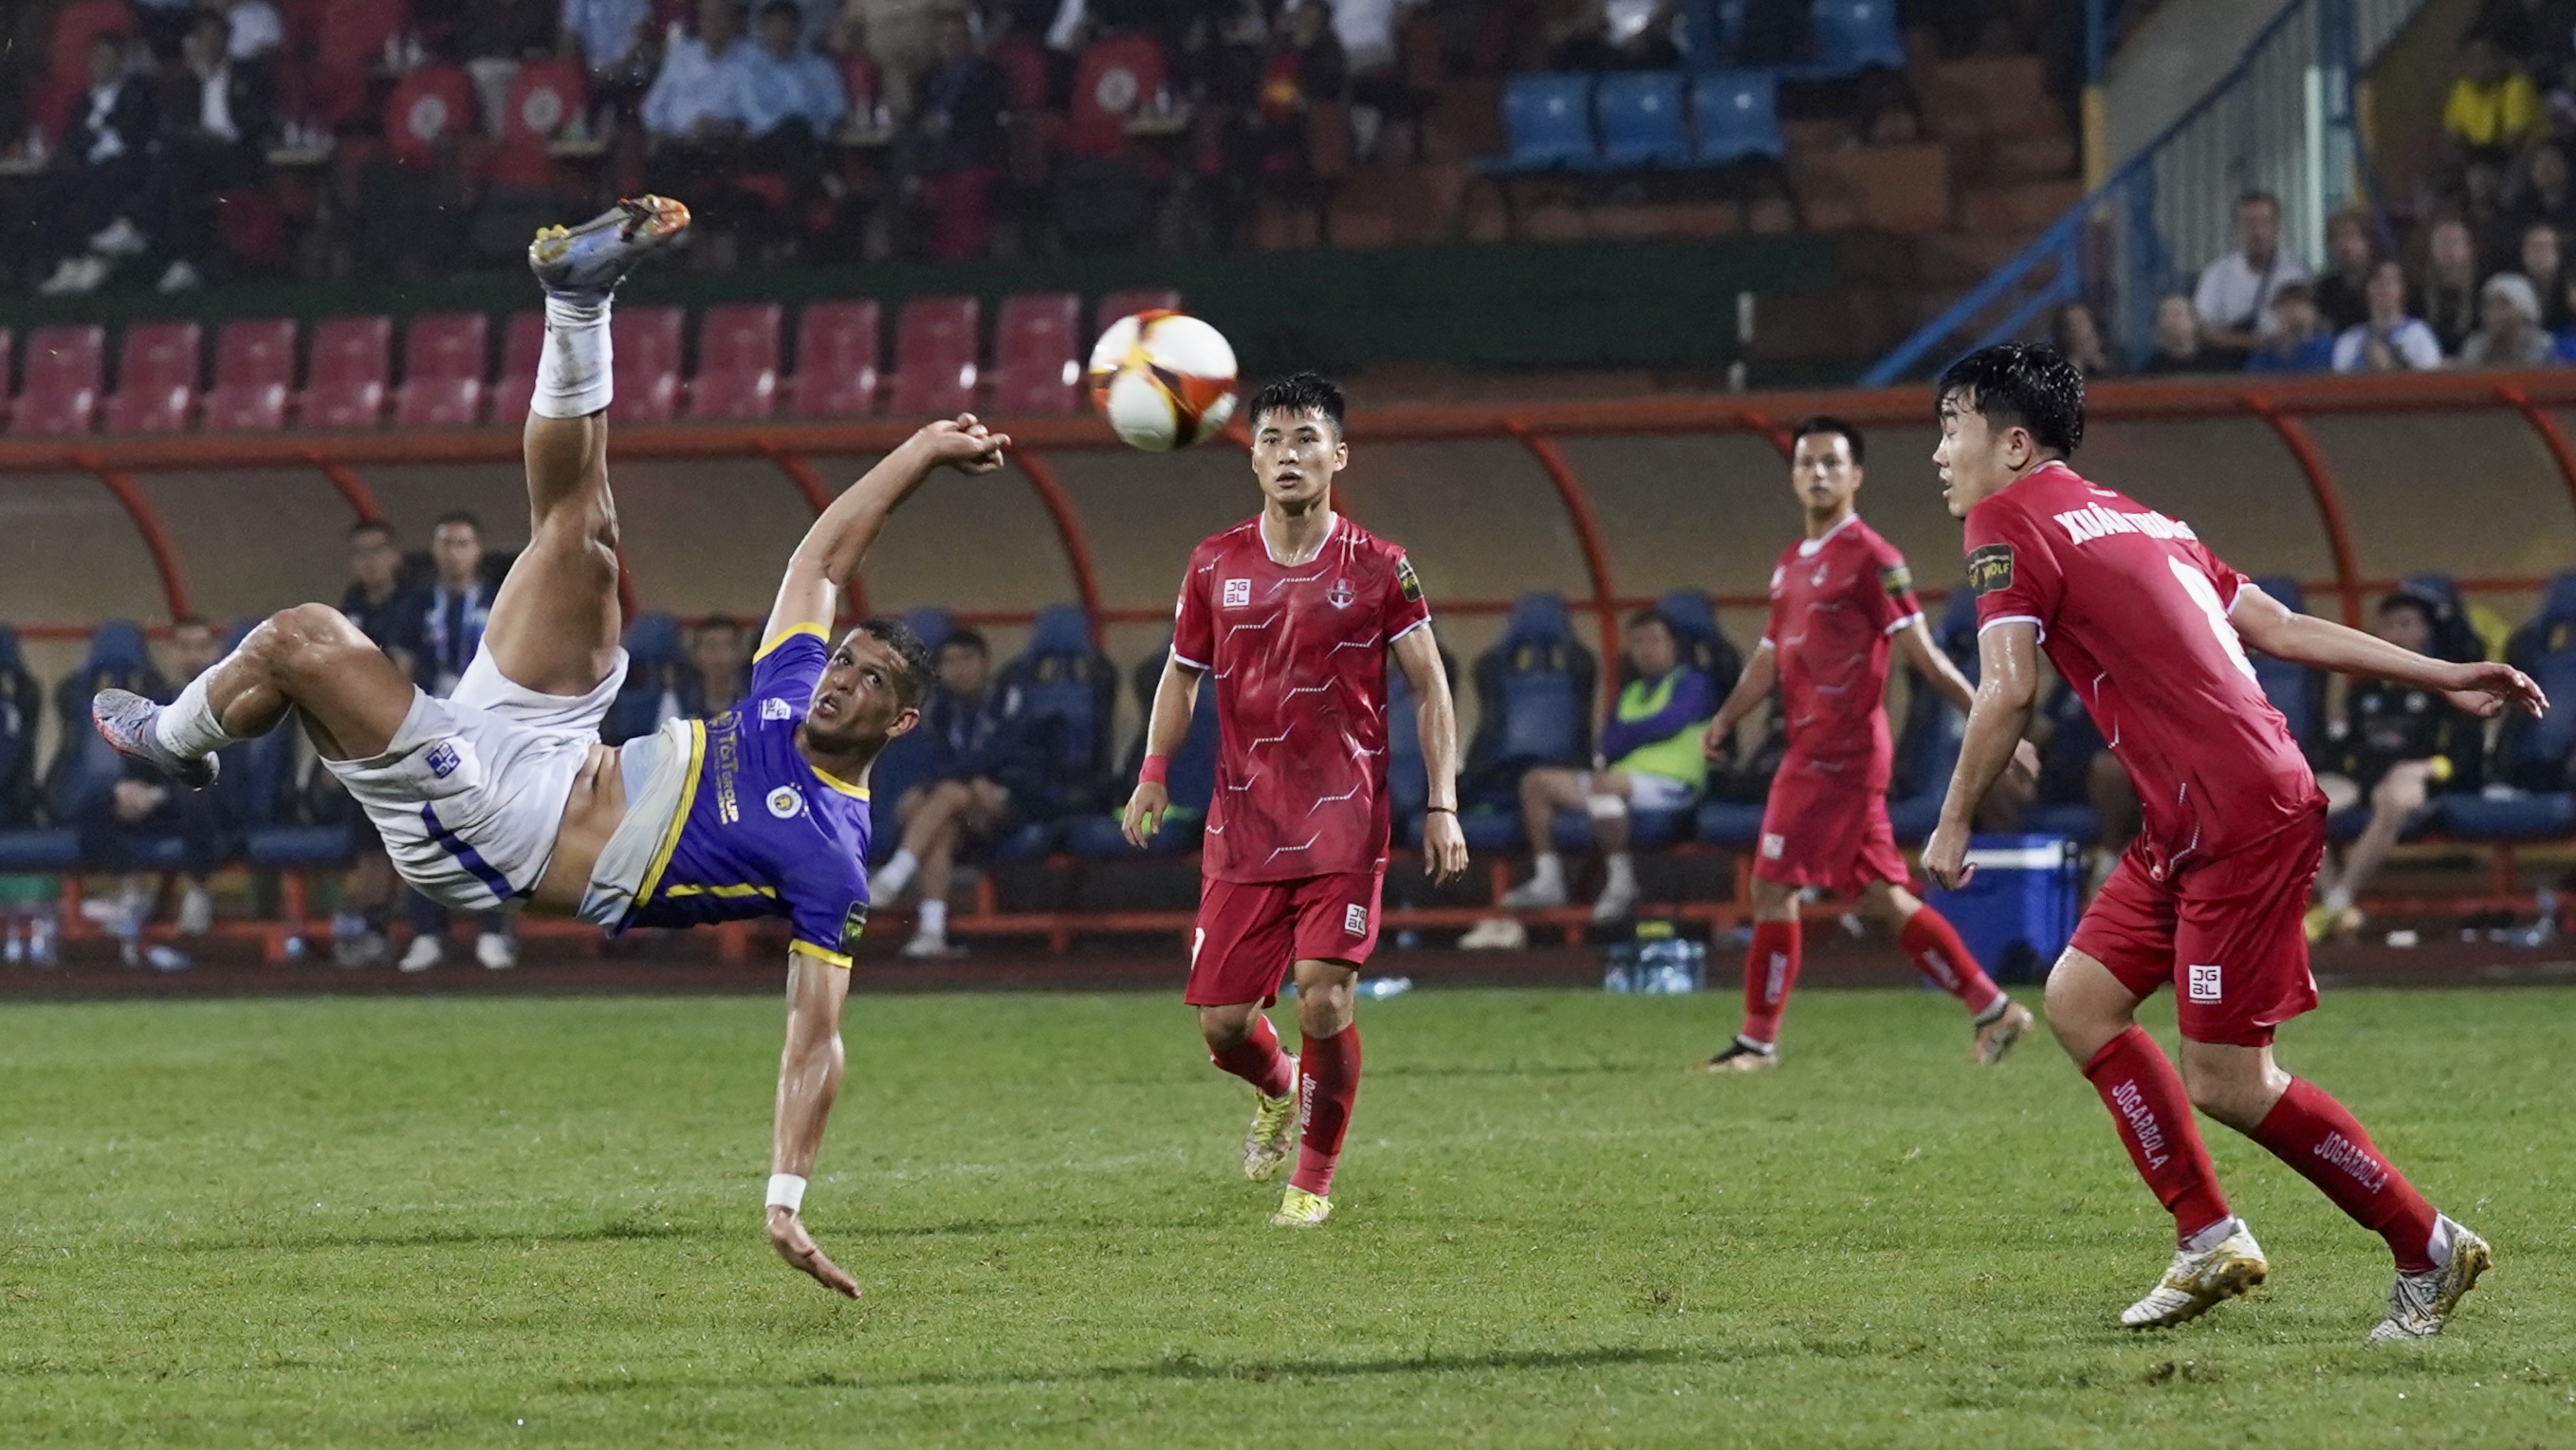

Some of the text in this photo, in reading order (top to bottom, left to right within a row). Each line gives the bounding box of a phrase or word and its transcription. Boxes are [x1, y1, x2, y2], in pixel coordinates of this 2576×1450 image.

[1226, 581, 1248, 592] JG
[1225, 593, 1247, 604] BL
[2193, 969, 2217, 982] JG
[2193, 982, 2217, 995] BL
[2111, 1078, 2170, 1170] JOGARBOLA
[2313, 1129, 2389, 1195] JOGARBOLA
